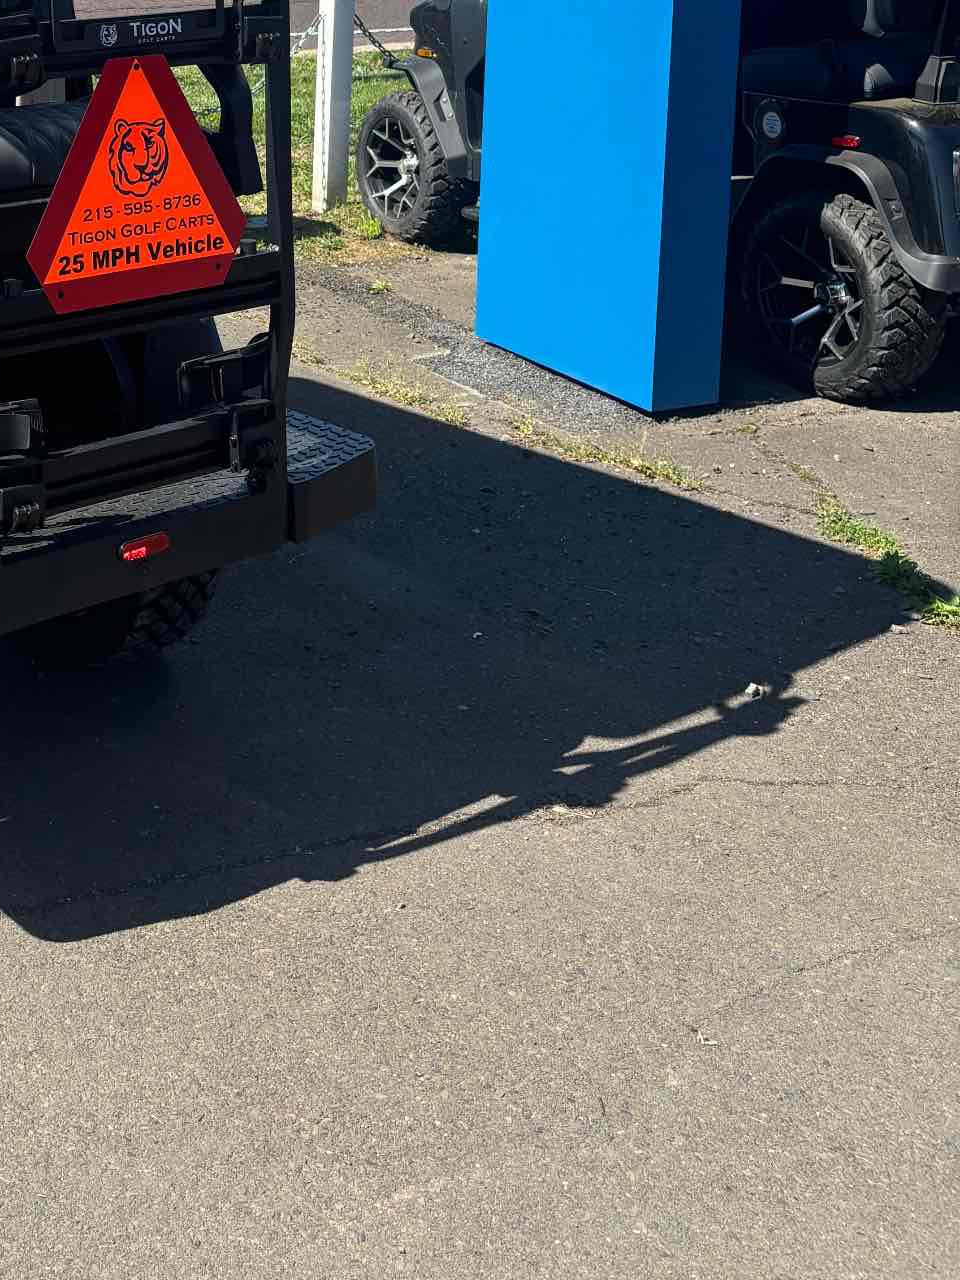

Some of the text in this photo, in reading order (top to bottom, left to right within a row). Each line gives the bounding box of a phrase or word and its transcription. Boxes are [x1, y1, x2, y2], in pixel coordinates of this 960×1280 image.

[129, 17, 182, 37] TIGON
[68, 214, 215, 246] TIGON GOLF CARTS
[58, 233, 225, 276] 25 MPH Vehicle
